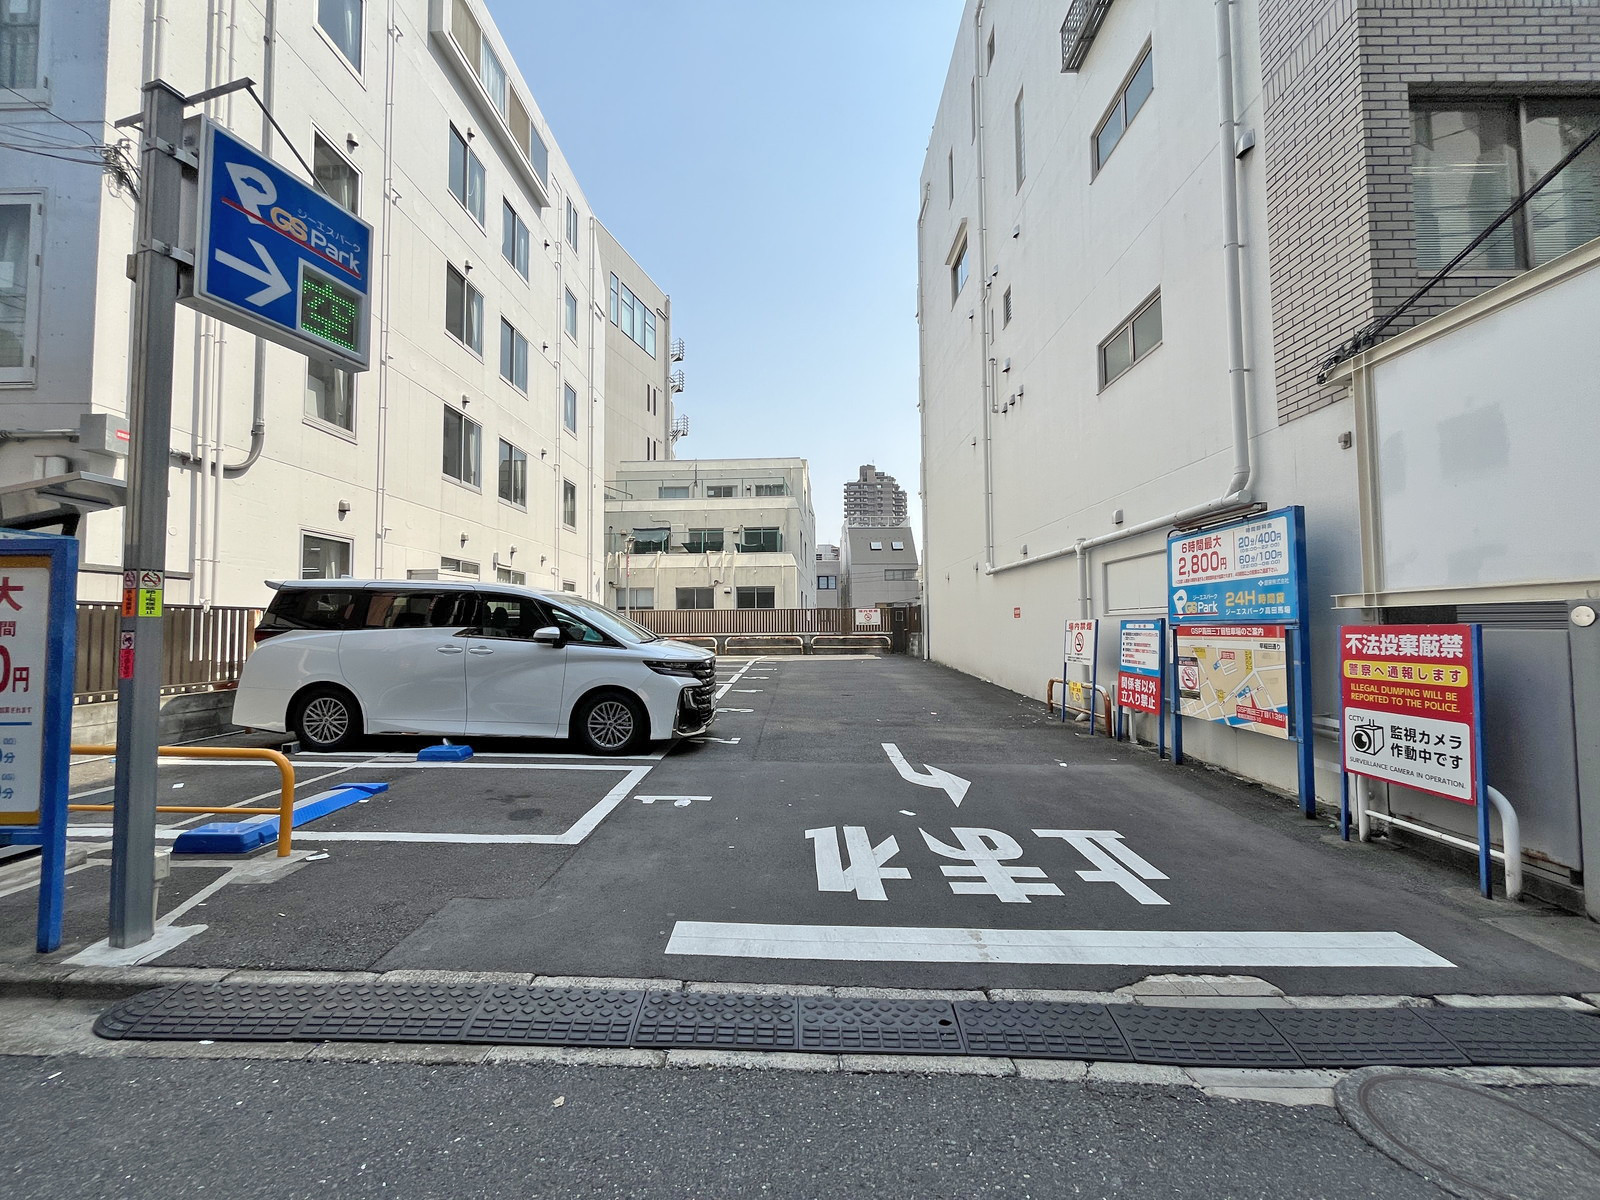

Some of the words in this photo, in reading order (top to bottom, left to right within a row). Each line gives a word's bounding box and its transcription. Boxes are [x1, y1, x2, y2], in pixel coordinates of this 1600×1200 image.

[297, 208, 361, 253] ジーエスパーク
[303, 280, 356, 351] 空
[1182, 535, 1221, 553] 6時間最大
[1179, 551, 1227, 577] 2,800円
[1225, 590, 1256, 606] 24H
[1345, 633, 1463, 658] 不法投棄厳禁
[1121, 676, 1156, 695] 関係者以外
[1349, 663, 1461, 683] 警察へ通報します
[1121, 691, 1155, 710] 立入り禁止
[1351, 683, 1379, 693] ILLEGAL
[1381, 686, 1420, 698] DUMPING
[1422, 689, 1442, 700] WILL
[1446, 692, 1457, 701] BE
[1351, 692, 1388, 704] REPORTED
[1392, 697, 1403, 706] TO
[1406, 699, 1422, 708] THE
[1424, 701, 1460, 713] POLICE.
[1390, 725, 1462, 750] 監視カメラ
[1391, 743, 1463, 769] 作動中です
[1350, 757, 1388, 771] SURVEILLANCE
[1390, 765, 1415, 777] CAMERA
[1425, 774, 1466, 789] OPERATION.
[804, 825, 1171, 905] 止まれ
